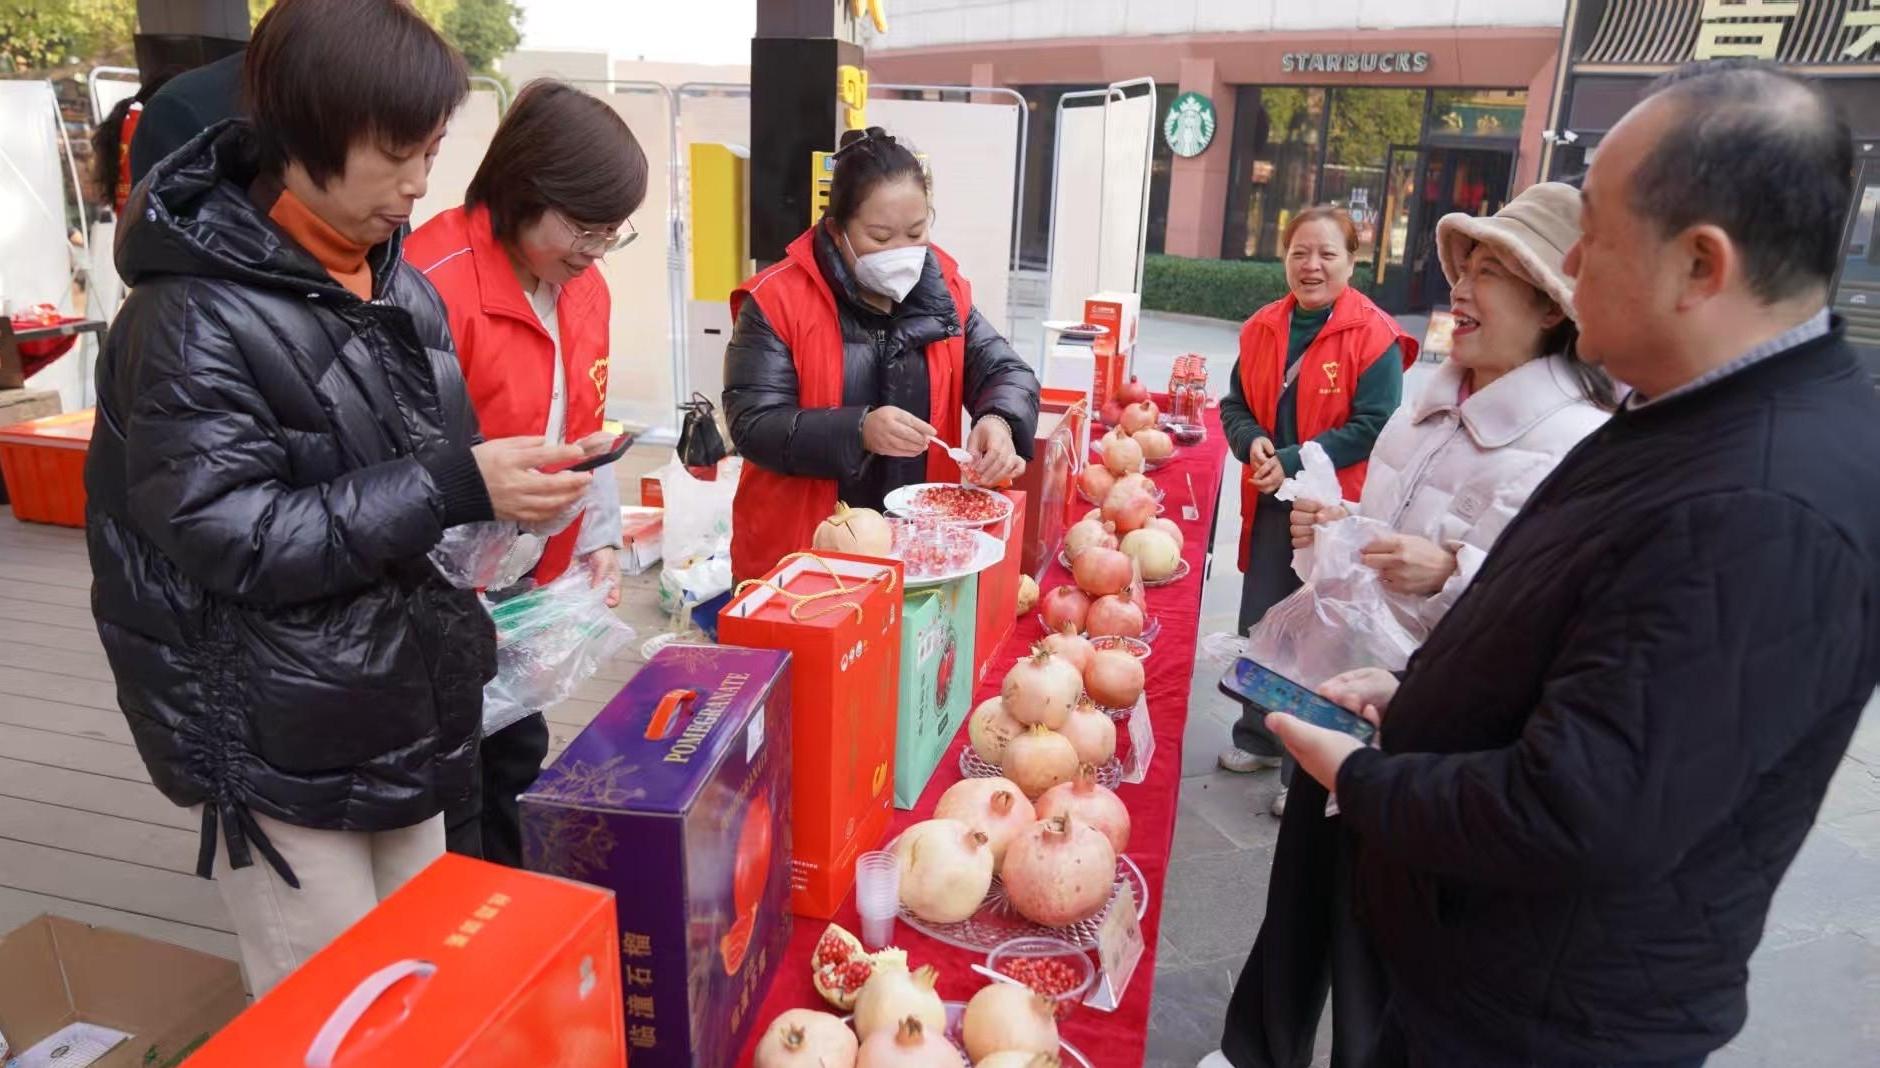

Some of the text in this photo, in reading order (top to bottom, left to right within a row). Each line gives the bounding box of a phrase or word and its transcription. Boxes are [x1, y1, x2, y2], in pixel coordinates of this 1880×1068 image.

[1281, 52, 1429, 73] STARBUCKS
[663, 672, 751, 763] POMEGRANATE
[622, 931, 657, 1048] 临潼石榴
